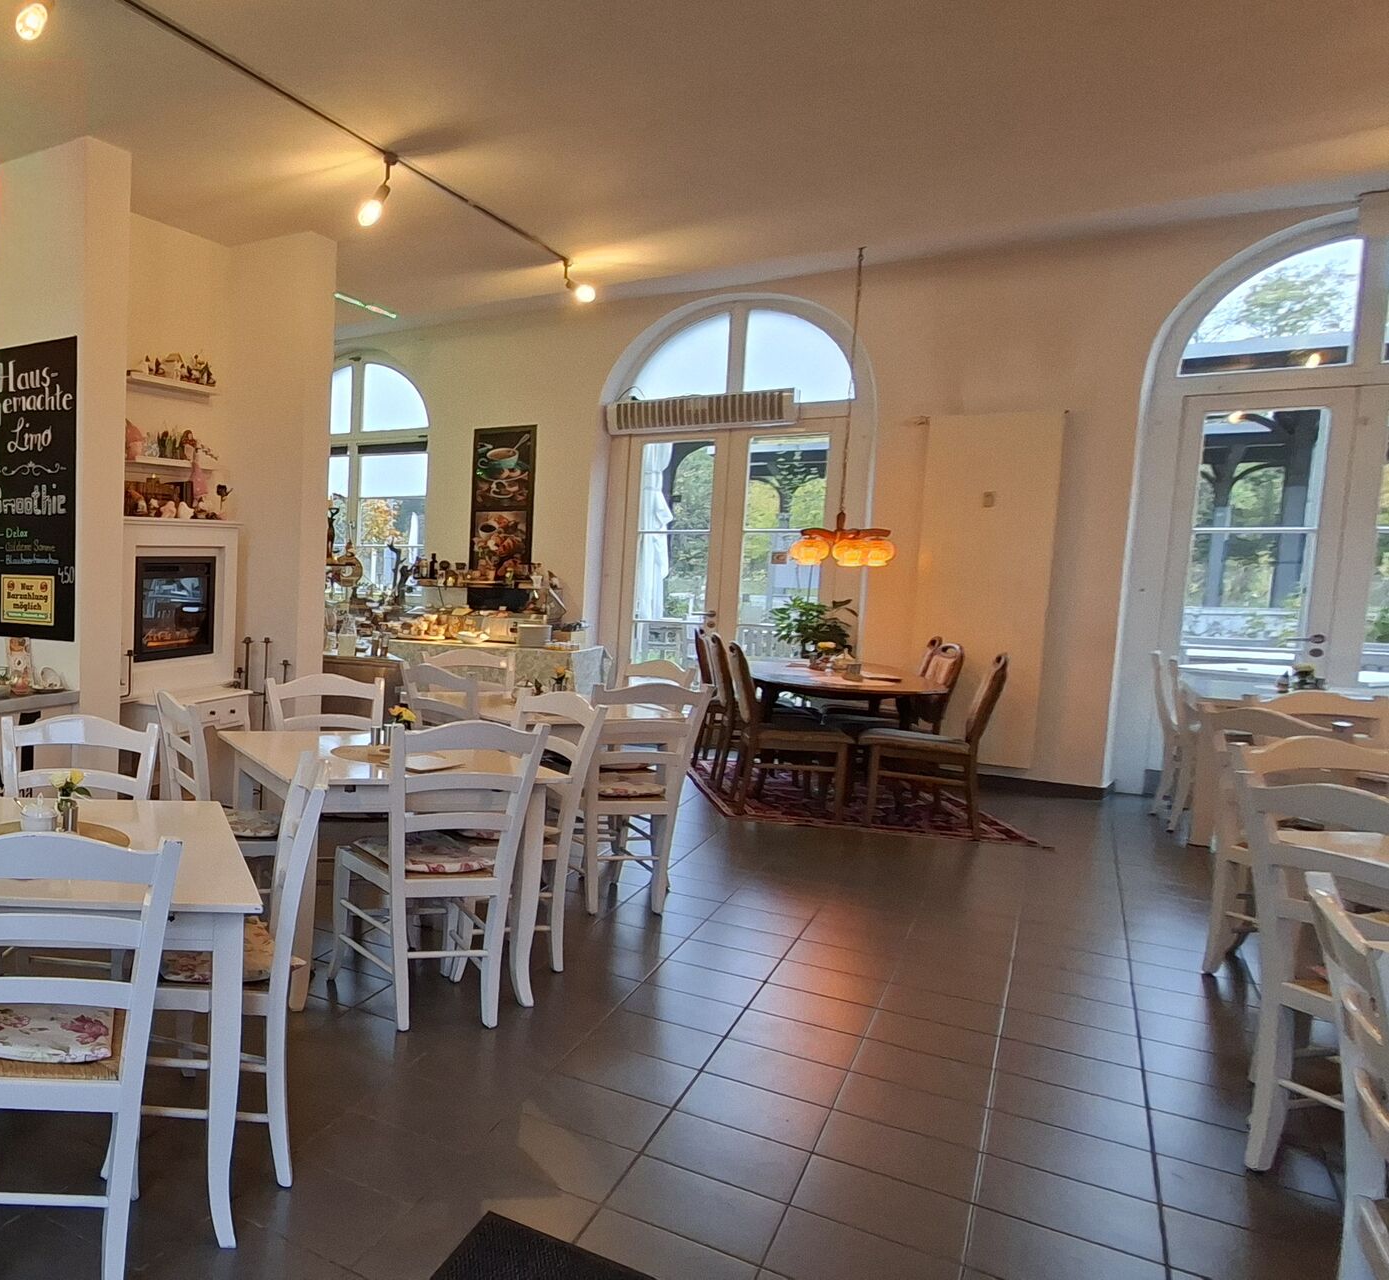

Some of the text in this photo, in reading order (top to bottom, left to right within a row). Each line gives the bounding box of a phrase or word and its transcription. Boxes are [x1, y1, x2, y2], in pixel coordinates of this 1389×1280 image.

[7, 416, 52, 453] Limo
[5, 527, 28, 538] Detox
[20, 582, 34, 591] Nur
[7, 592, 48, 602] Barzahlung
[12, 601, 42, 611] möglich
